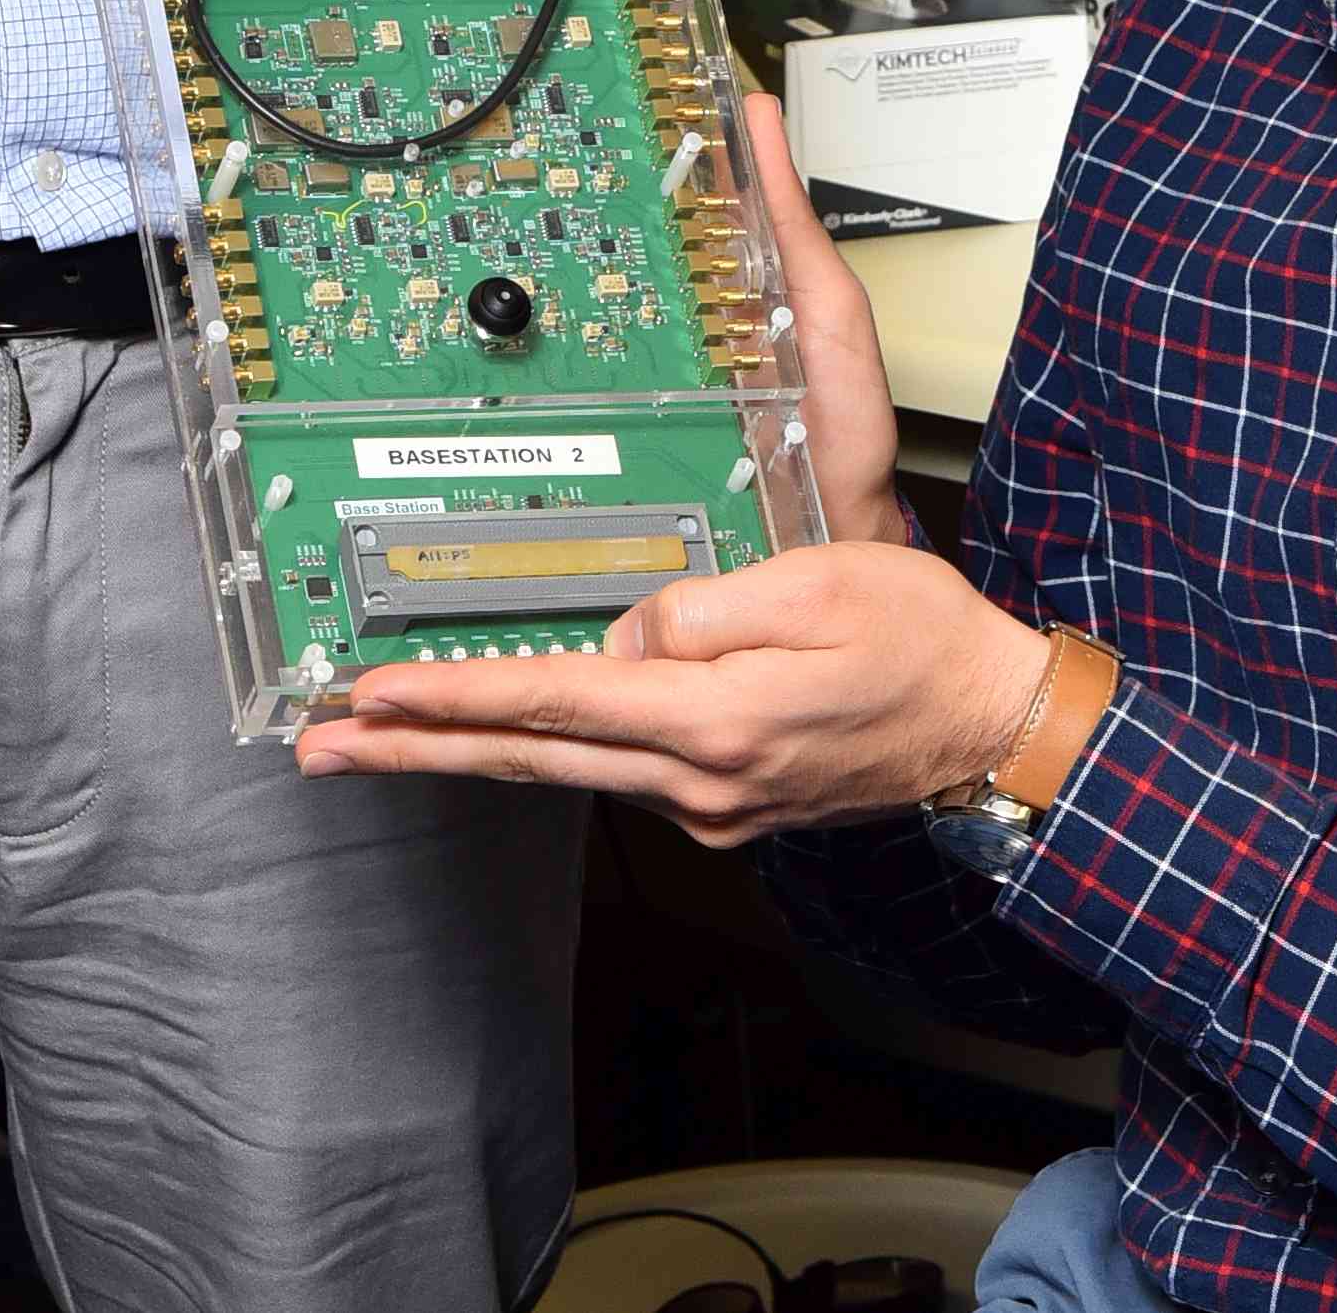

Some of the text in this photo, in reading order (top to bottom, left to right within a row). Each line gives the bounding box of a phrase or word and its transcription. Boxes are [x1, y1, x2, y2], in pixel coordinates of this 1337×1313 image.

[876, 46, 968, 72] KIMTECH
[388, 447, 585, 466] BASESTATION 2
[342, 501, 439, 516] Base Station
